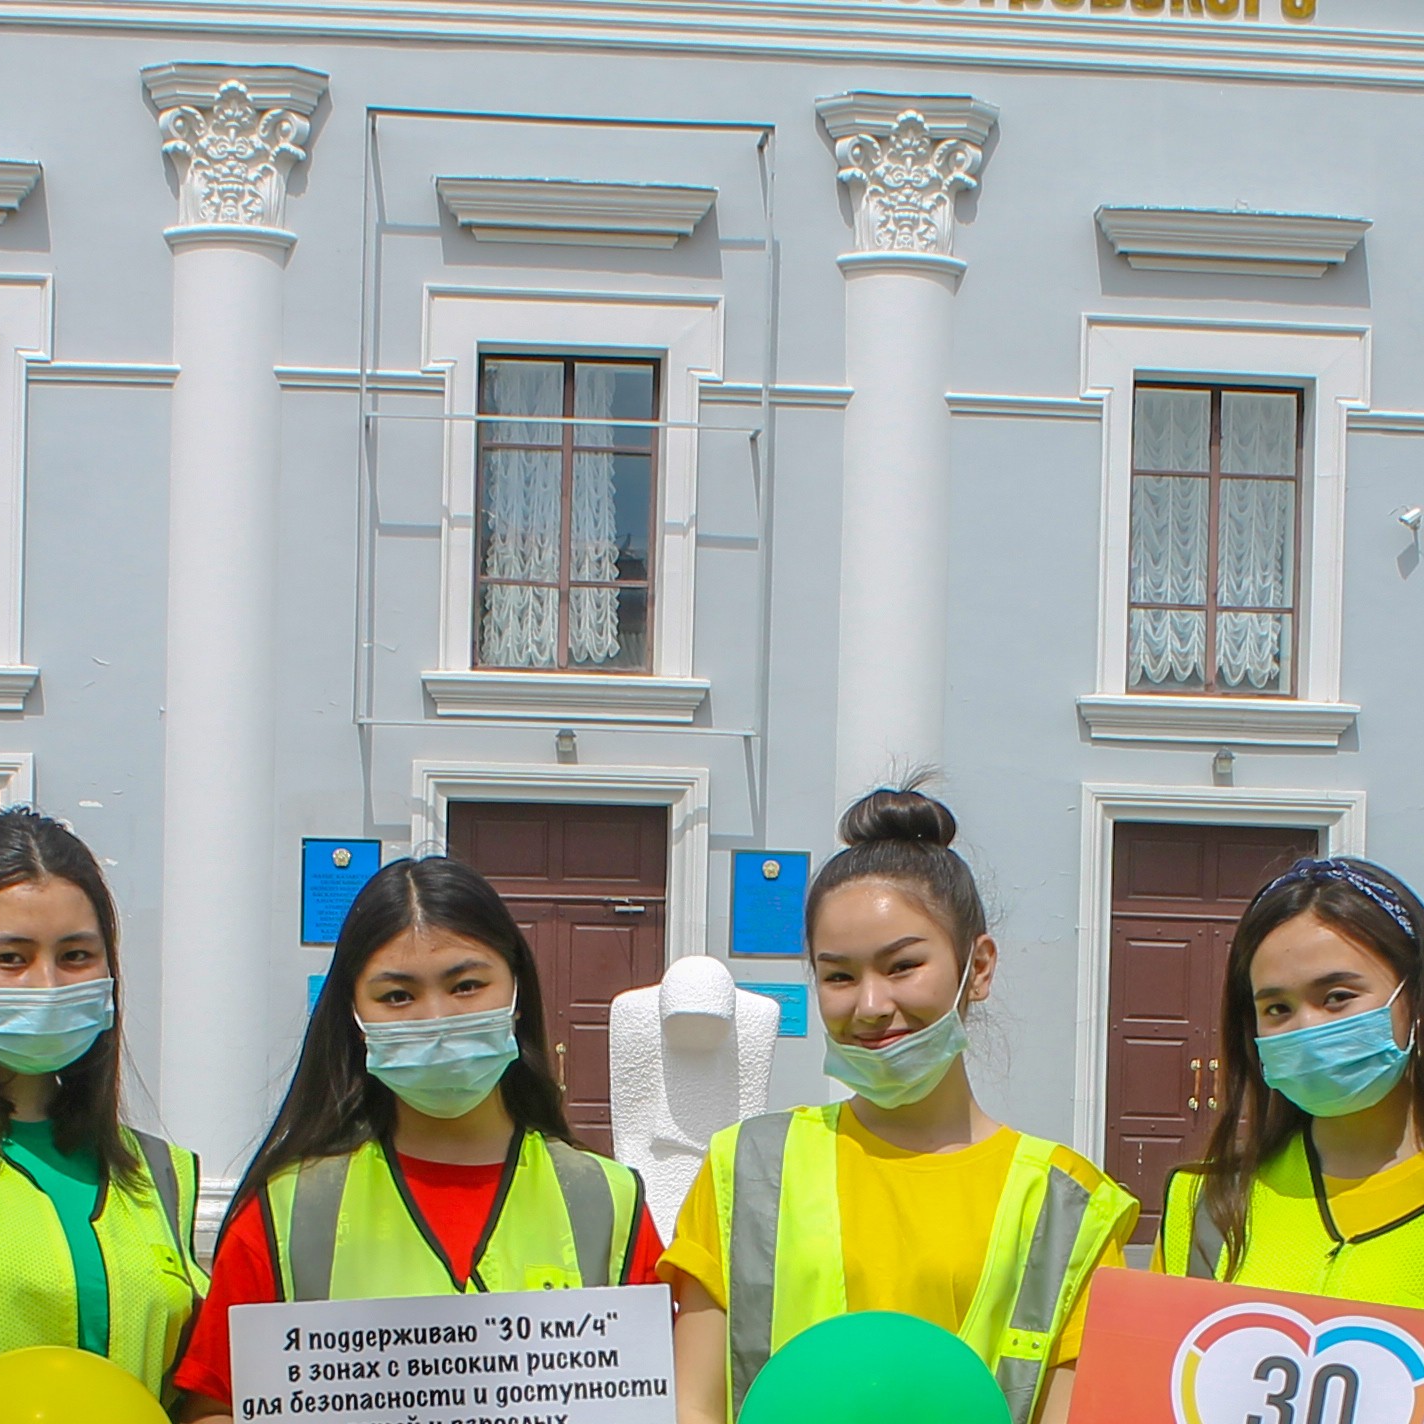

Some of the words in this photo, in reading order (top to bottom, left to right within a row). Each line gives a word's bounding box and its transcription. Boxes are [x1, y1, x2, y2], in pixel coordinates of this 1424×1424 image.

[283, 1327, 301, 1351] Я
[308, 1325, 478, 1353] поддерживаю
[484, 1316, 531, 1342] "30
[540, 1312, 618, 1339] км/ч"
[288, 1364, 301, 1383] в
[309, 1360, 381, 1382] зонах
[387, 1359, 400, 1378] с
[407, 1354, 519, 1377] высоким
[526, 1349, 619, 1374] риском
[242, 1397, 282, 1421] для
[290, 1388, 466, 1414] безопасности
[473, 1387, 487, 1405] и
[495, 1378, 667, 1409] доступности
